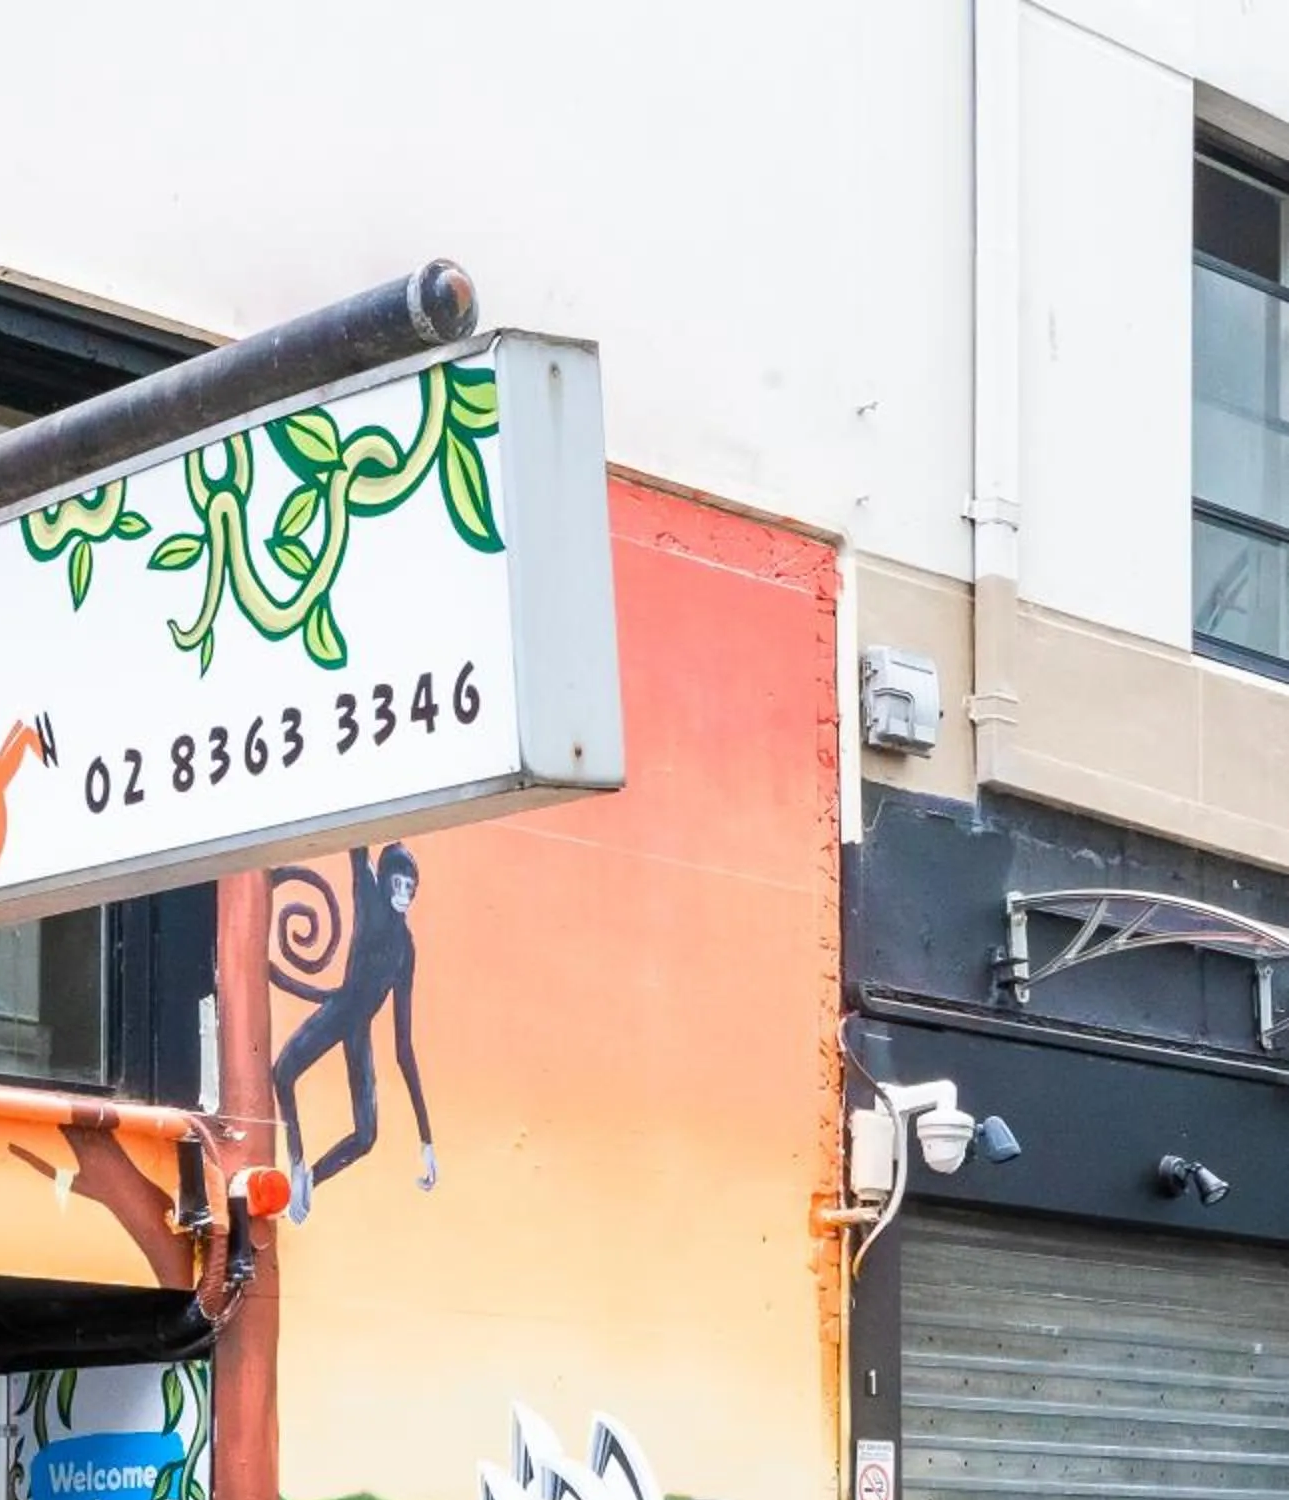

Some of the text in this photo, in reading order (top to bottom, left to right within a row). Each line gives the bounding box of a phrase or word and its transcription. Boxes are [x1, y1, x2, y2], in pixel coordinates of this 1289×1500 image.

[85, 661, 481, 814] 02 8363 3346
[868, 1369, 877, 1395] 1
[49, 1461, 159, 1493] Welcome
